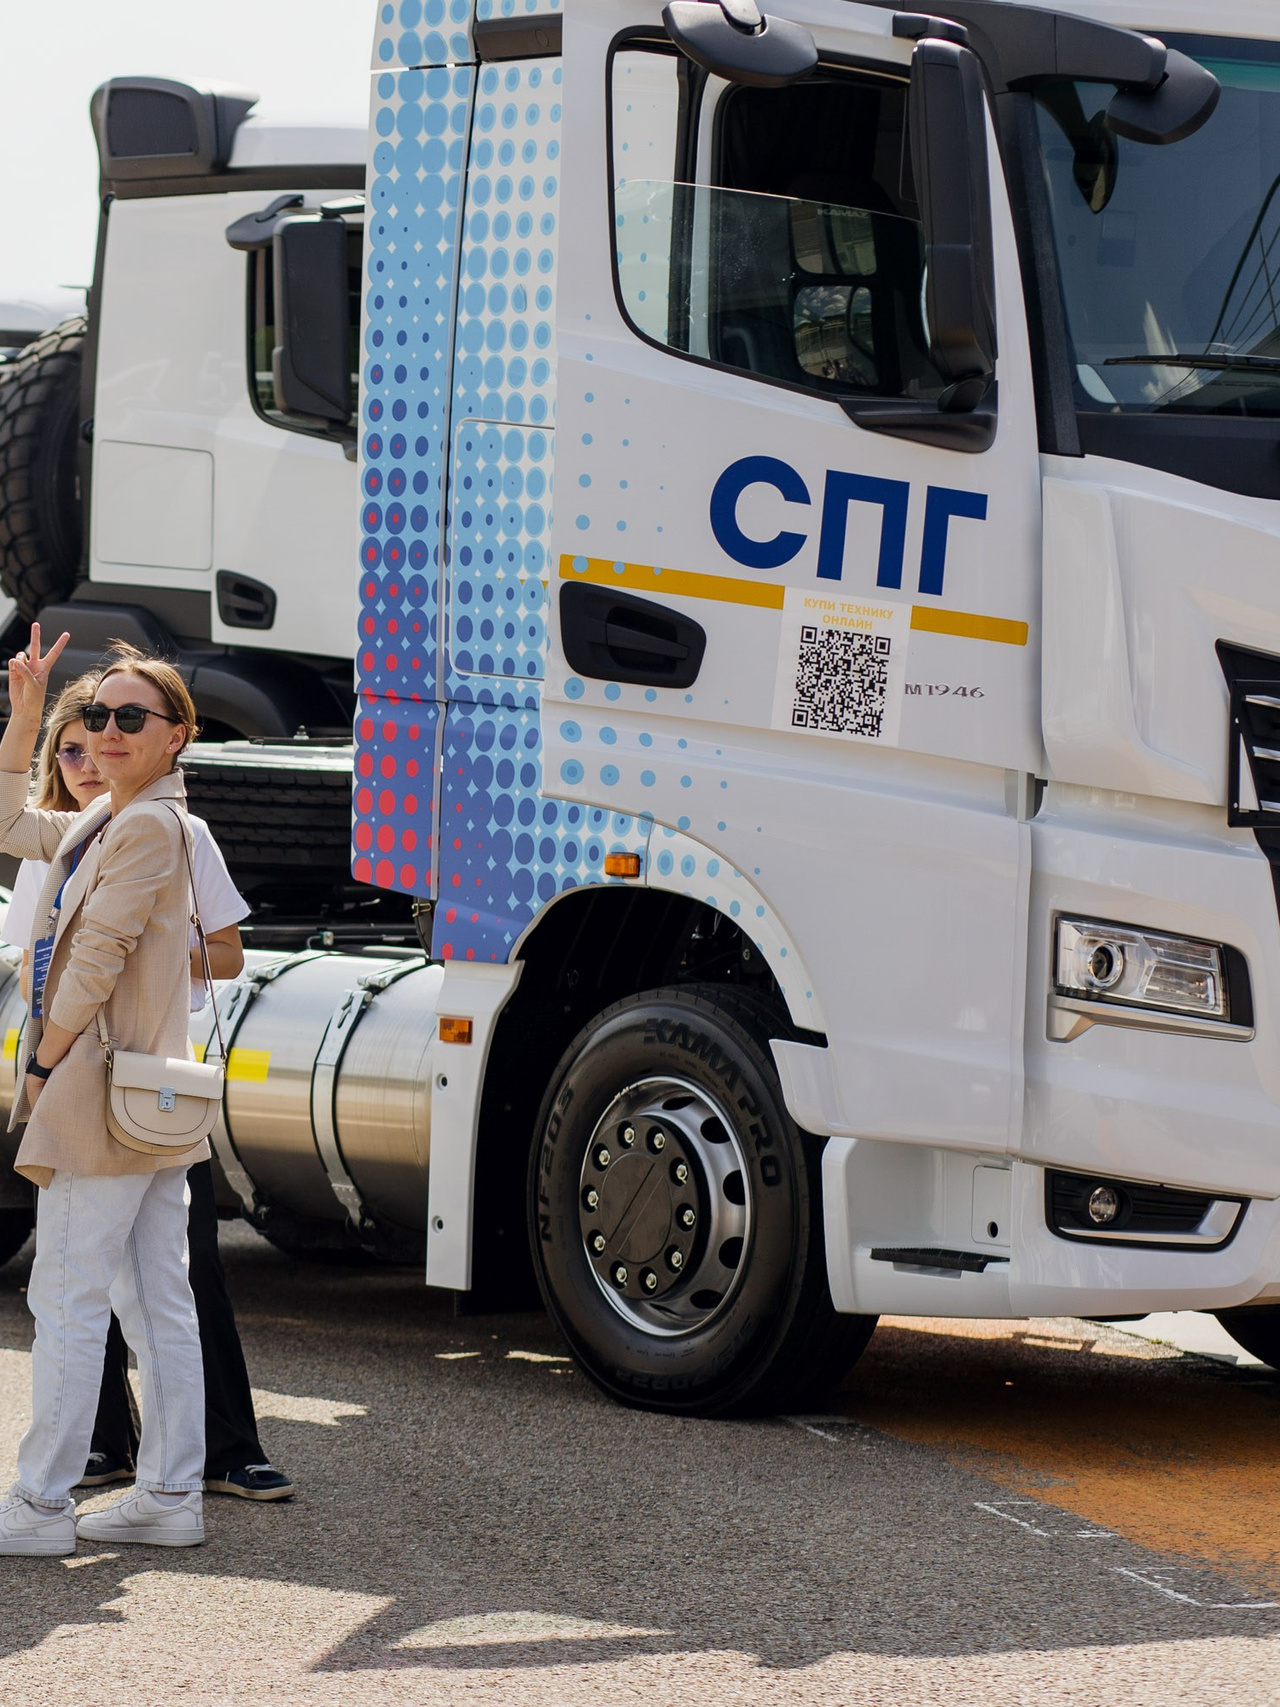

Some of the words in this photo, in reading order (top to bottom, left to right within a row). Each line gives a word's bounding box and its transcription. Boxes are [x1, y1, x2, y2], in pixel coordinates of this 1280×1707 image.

[710, 455, 988, 596] СПГ
[804, 597, 836, 611] КУПИ
[840, 603, 894, 620] ТЕХНИКУ
[822, 614, 873, 630] ОНЛАЙН
